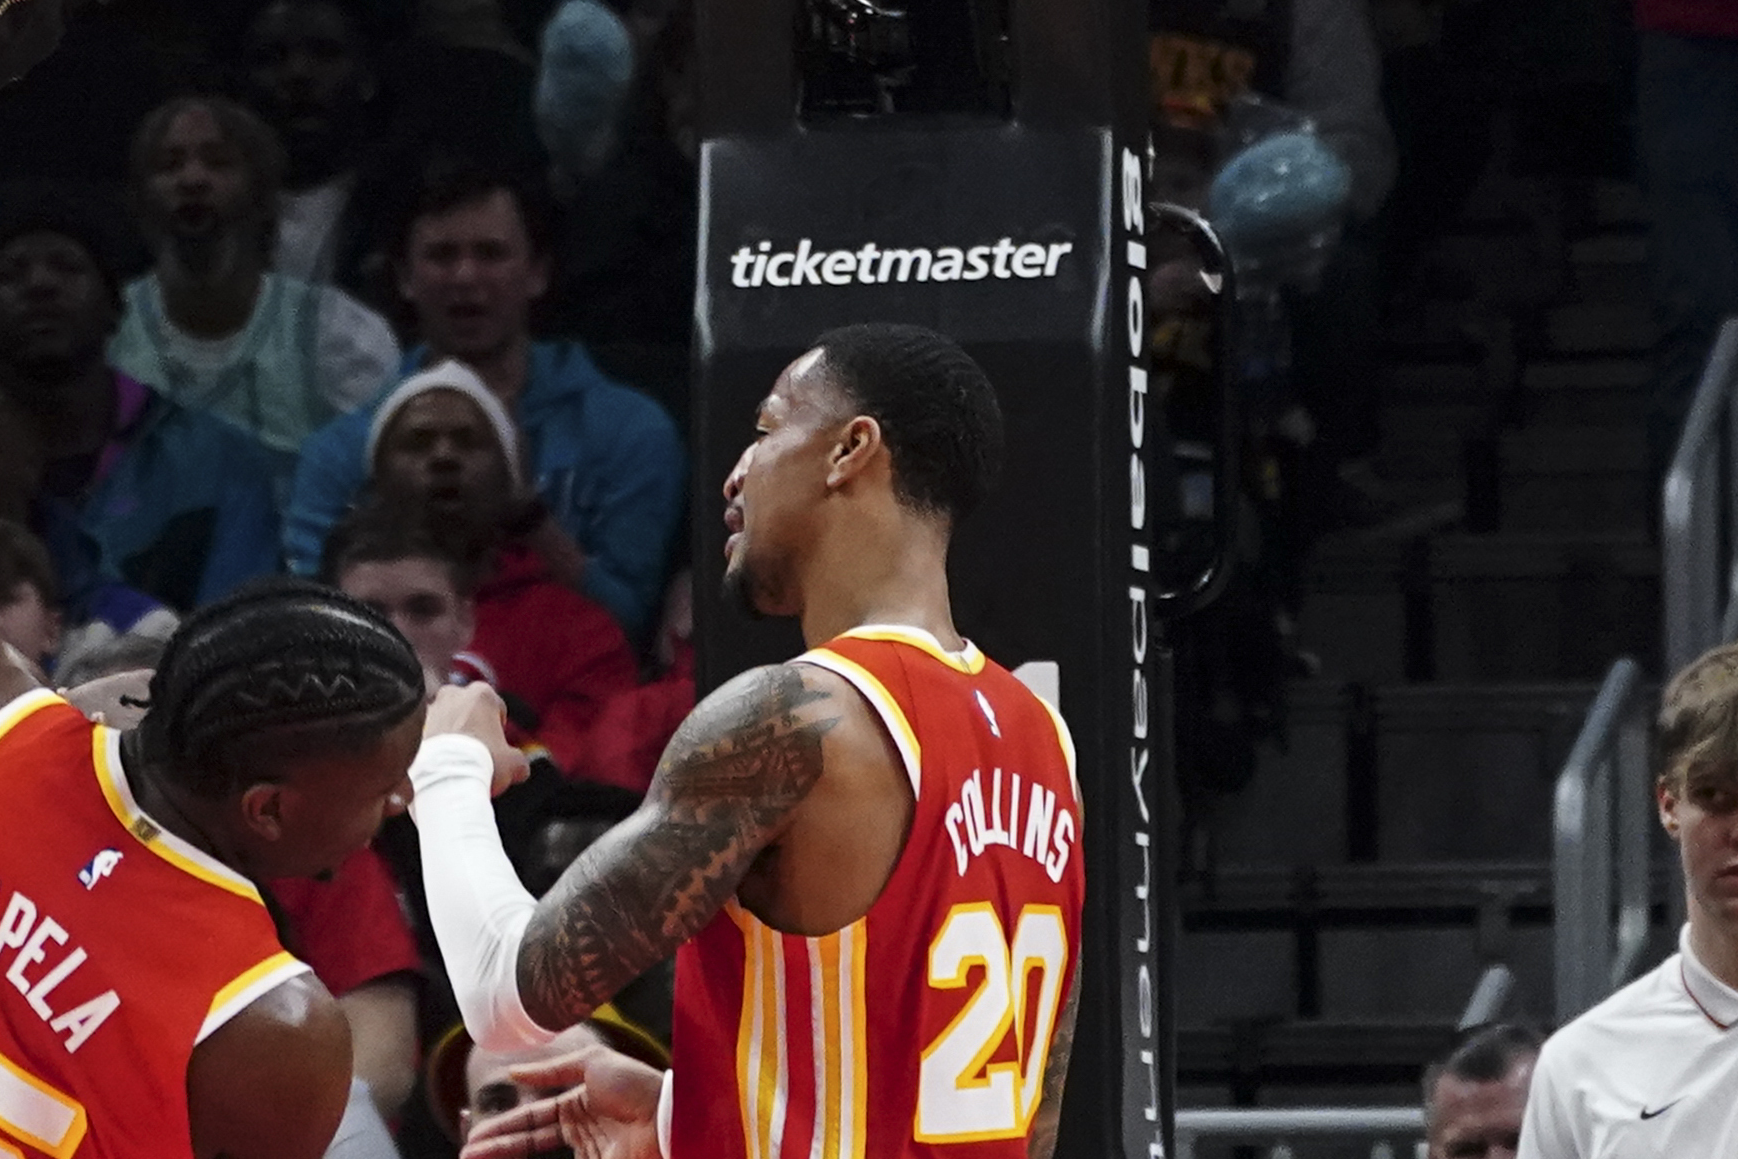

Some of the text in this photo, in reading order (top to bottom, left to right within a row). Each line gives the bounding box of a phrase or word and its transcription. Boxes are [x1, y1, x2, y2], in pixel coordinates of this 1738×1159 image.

[730, 237, 1073, 288] ticketmaster
[945, 767, 1075, 884] COLLINS
[913, 901, 1068, 1144] 20
